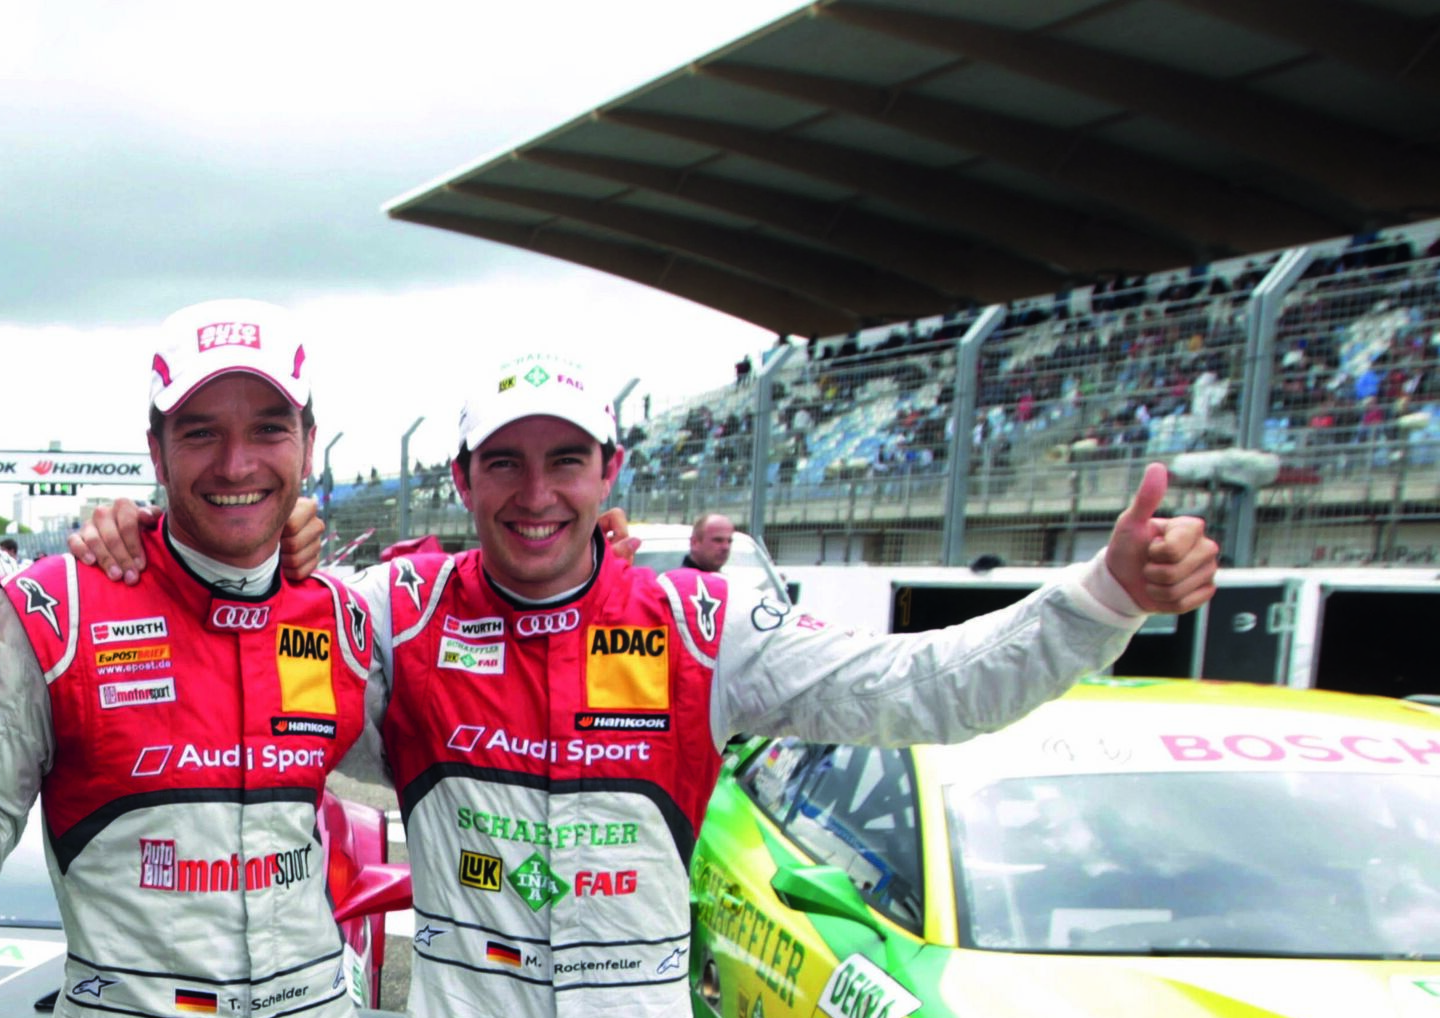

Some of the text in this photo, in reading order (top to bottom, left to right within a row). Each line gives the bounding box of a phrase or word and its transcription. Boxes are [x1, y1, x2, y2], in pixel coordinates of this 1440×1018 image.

[279, 628, 330, 661] ADAC
[591, 628, 665, 657] ADAC
[97, 660, 172, 675] www.epost.de
[117, 686, 172, 704] motorsport
[177, 745, 324, 772] Audi Sport
[486, 731, 651, 766] Audi Sport
[1160, 735, 1440, 764] BOSCH
[458, 807, 639, 850] SCHAEFFLER
[143, 841, 173, 865] Auto
[143, 865, 173, 888] Bild
[574, 869, 638, 897] FAG
[525, 955, 642, 974] M. Rockenfeller
[228, 998, 241, 1010] T.
